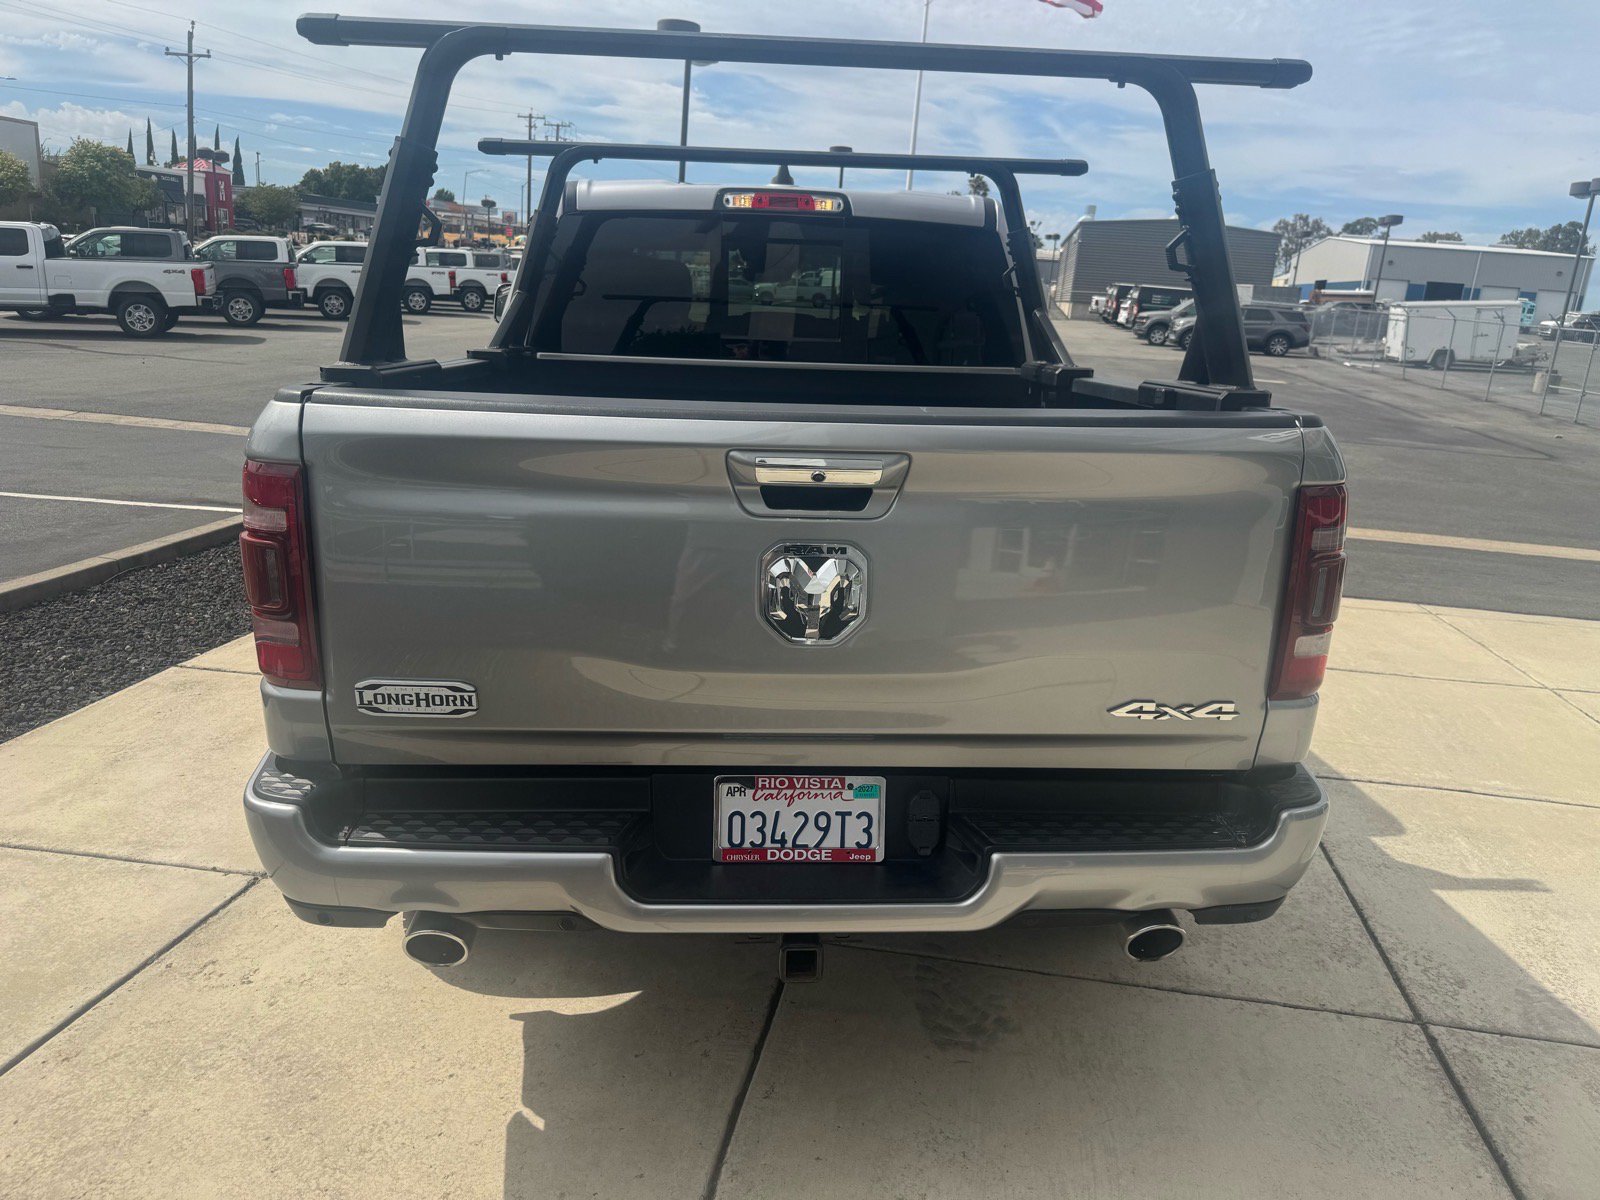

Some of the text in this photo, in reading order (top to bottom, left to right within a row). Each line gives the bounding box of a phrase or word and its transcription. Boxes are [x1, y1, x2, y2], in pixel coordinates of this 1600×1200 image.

[783, 546, 848, 555] RAM
[357, 691, 474, 708] LONGHORN
[758, 777, 842, 789] RIO VISTA
[726, 786, 747, 797] APR
[752, 788, 854, 807] California
[727, 810, 874, 849] 03429T3
[767, 849, 832, 861] DODGE
[849, 853, 871, 861] Jeep
